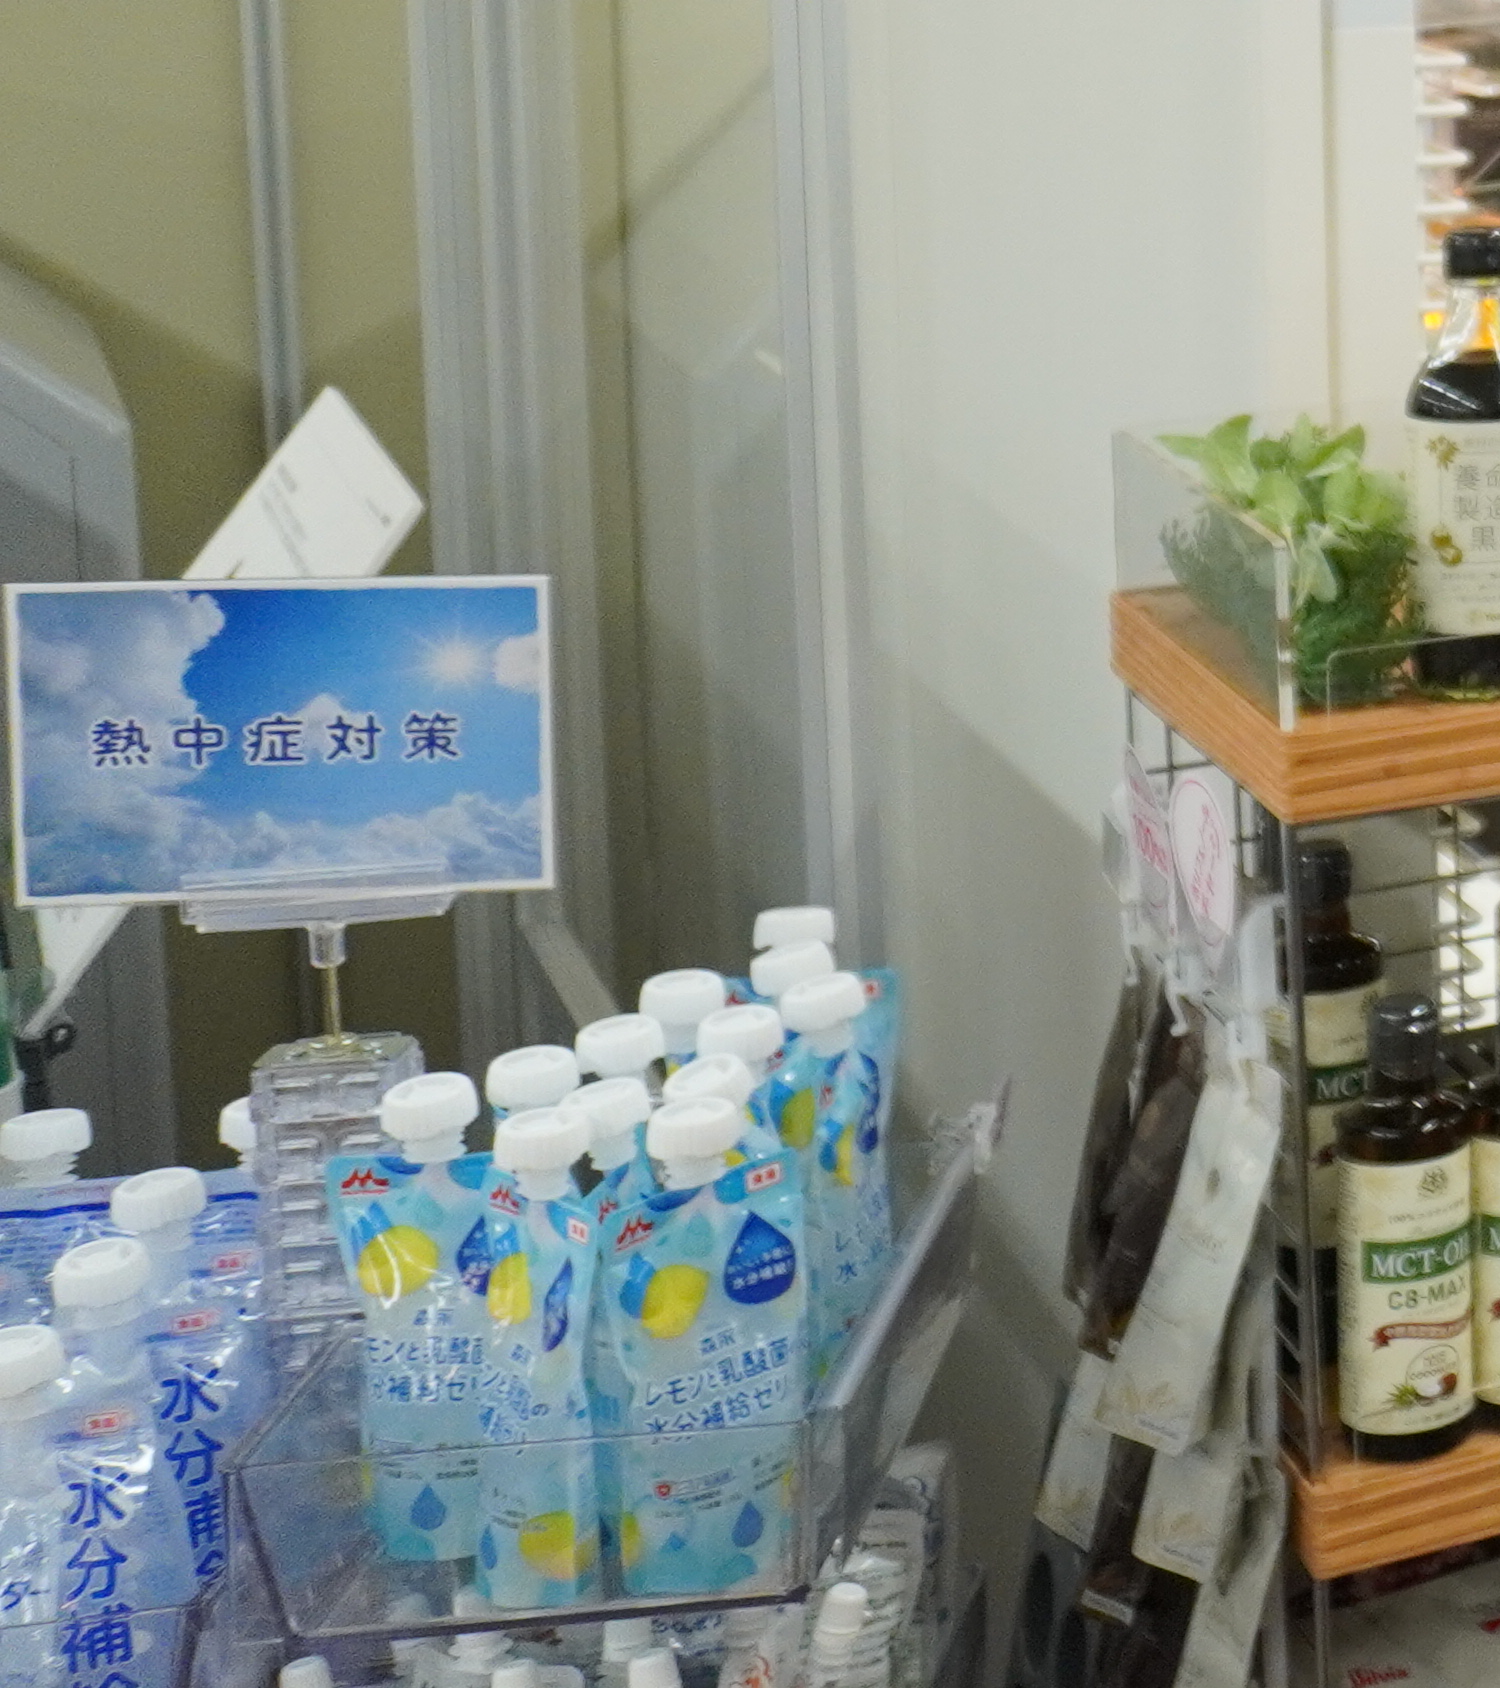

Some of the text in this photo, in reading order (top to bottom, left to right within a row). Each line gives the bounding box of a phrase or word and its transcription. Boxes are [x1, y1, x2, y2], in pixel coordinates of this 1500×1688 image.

[92, 713, 460, 769] 熱中症対策
